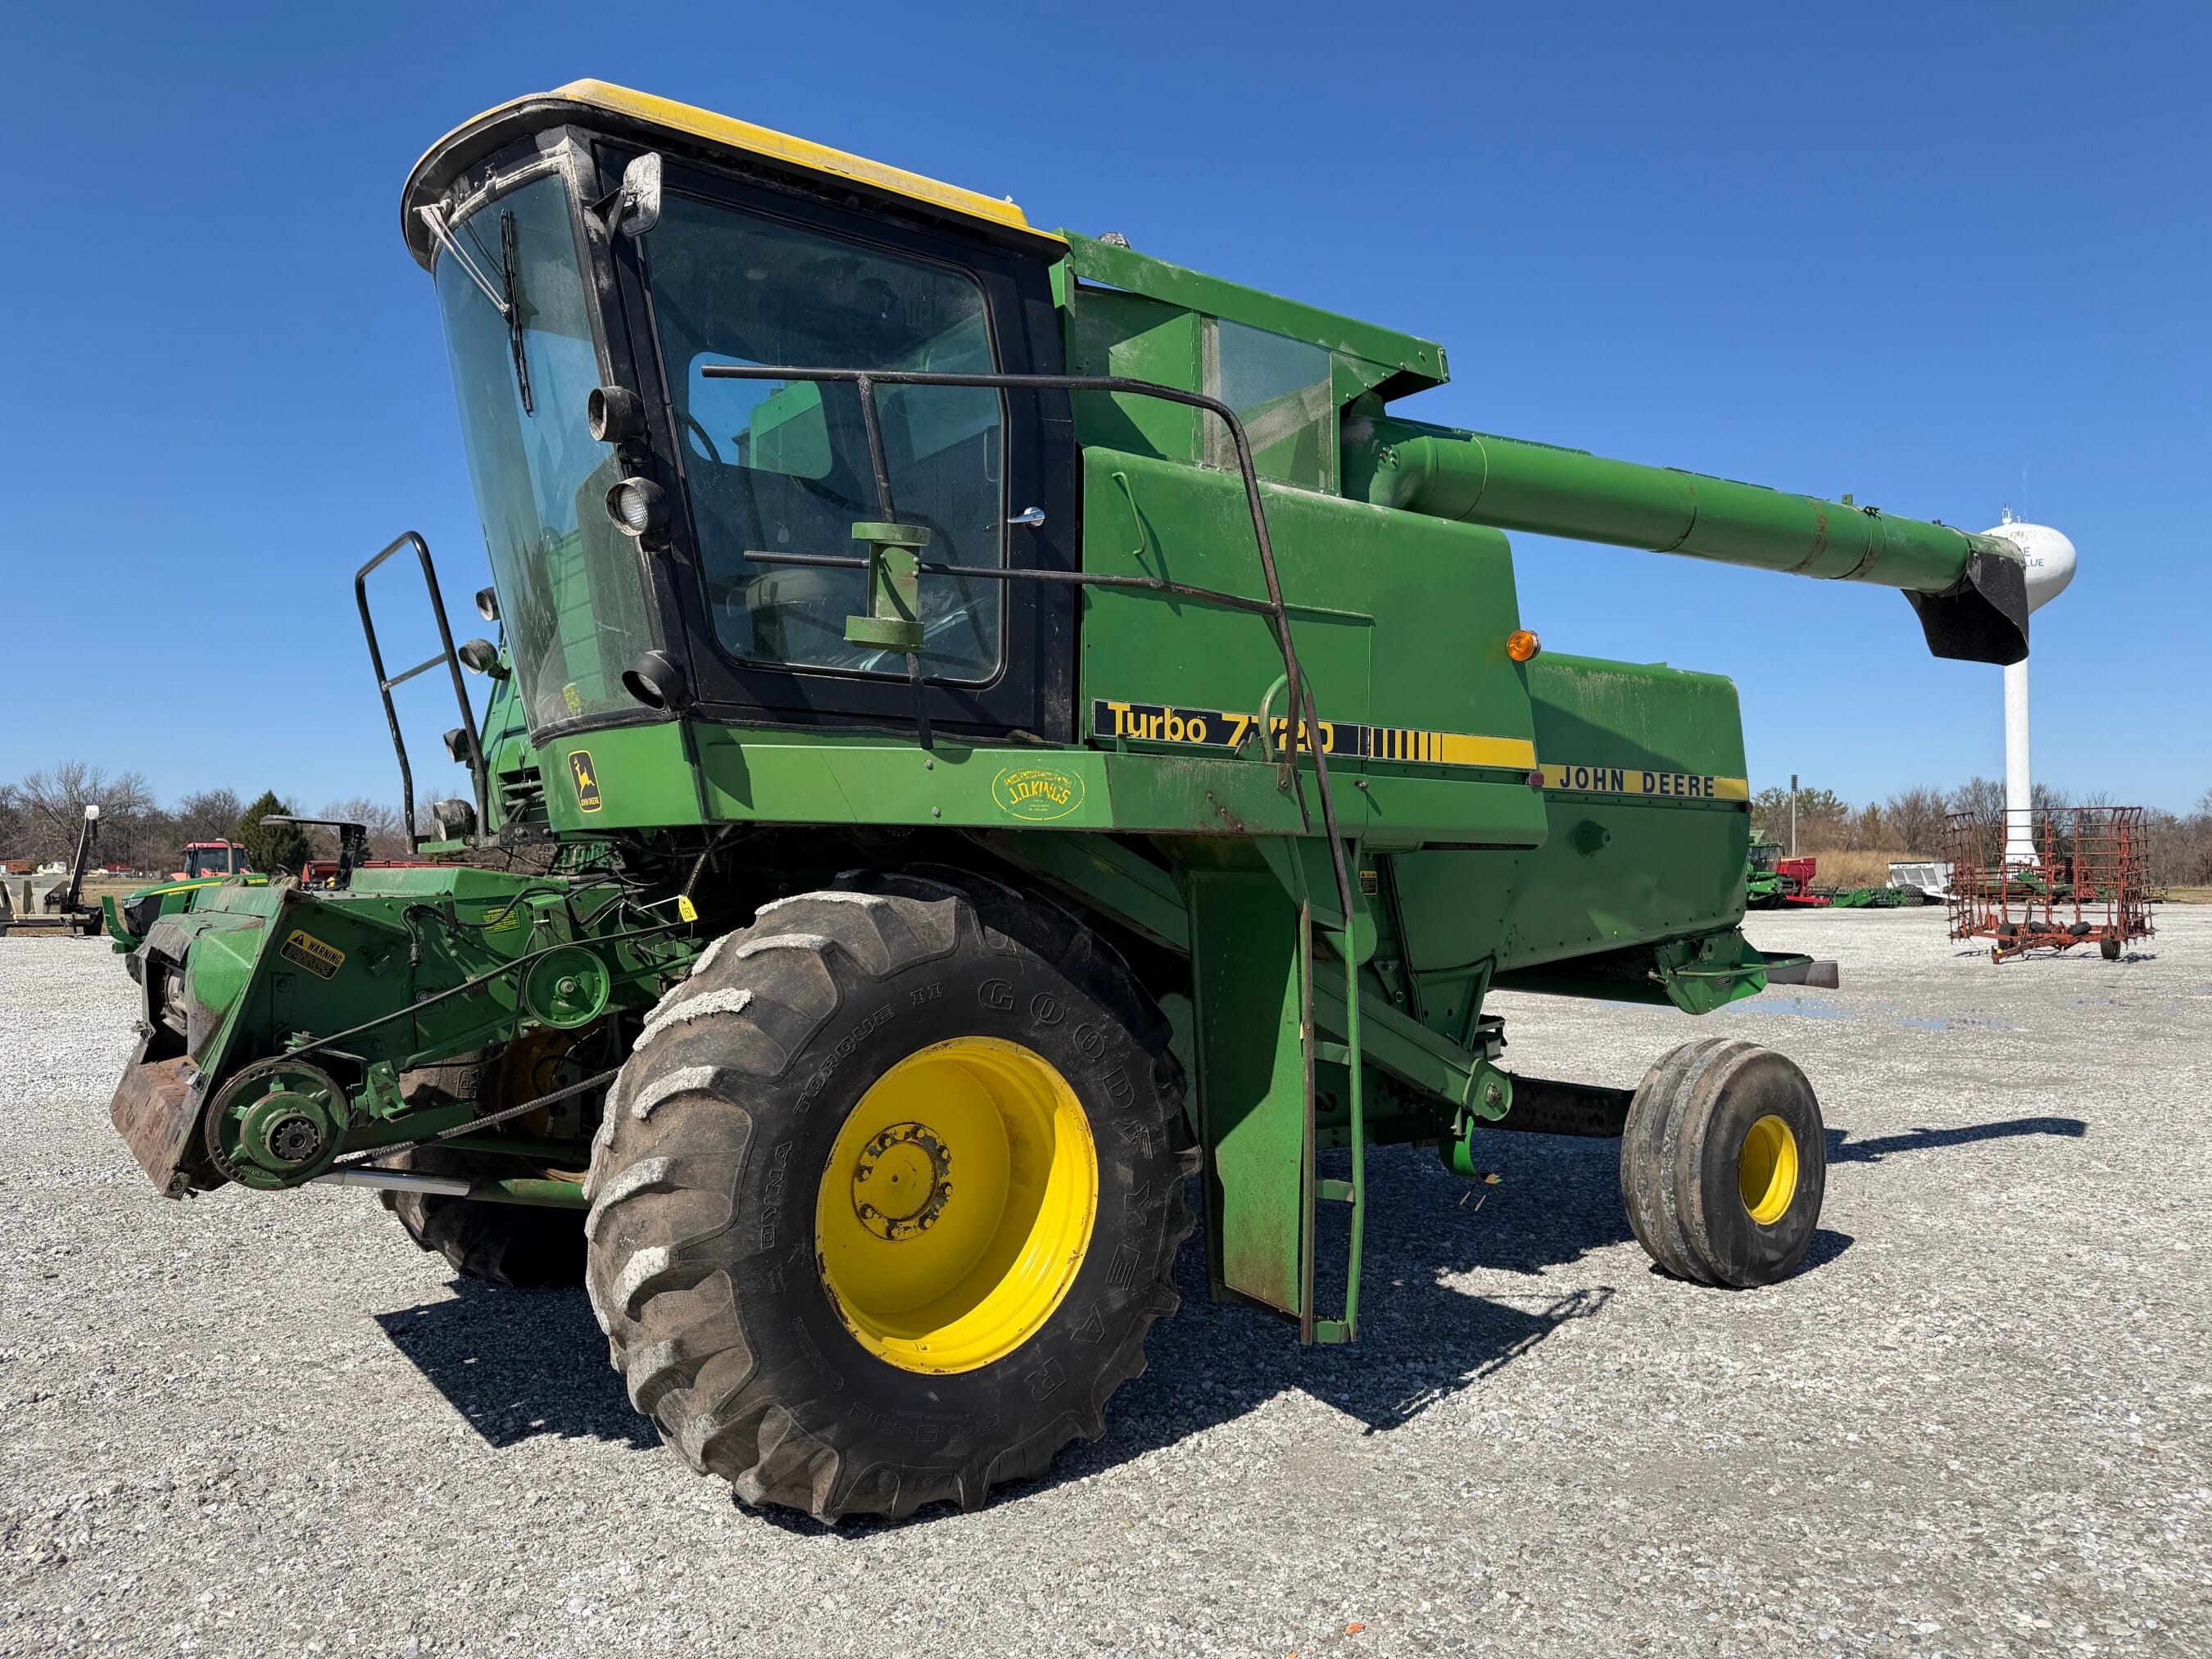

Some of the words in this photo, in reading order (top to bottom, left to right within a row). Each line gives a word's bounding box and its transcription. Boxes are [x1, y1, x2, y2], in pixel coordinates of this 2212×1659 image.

[1108, 702, 1207, 744] Turbo
[1222, 713, 1335, 755] 7720
[1560, 766, 1625, 791] JOHN
[1643, 772, 1715, 797] DEERE
[307, 940, 342, 965] WARNING
[760, 1140, 793, 1252] DYNA
[793, 1004, 895, 1115] TORQUE
